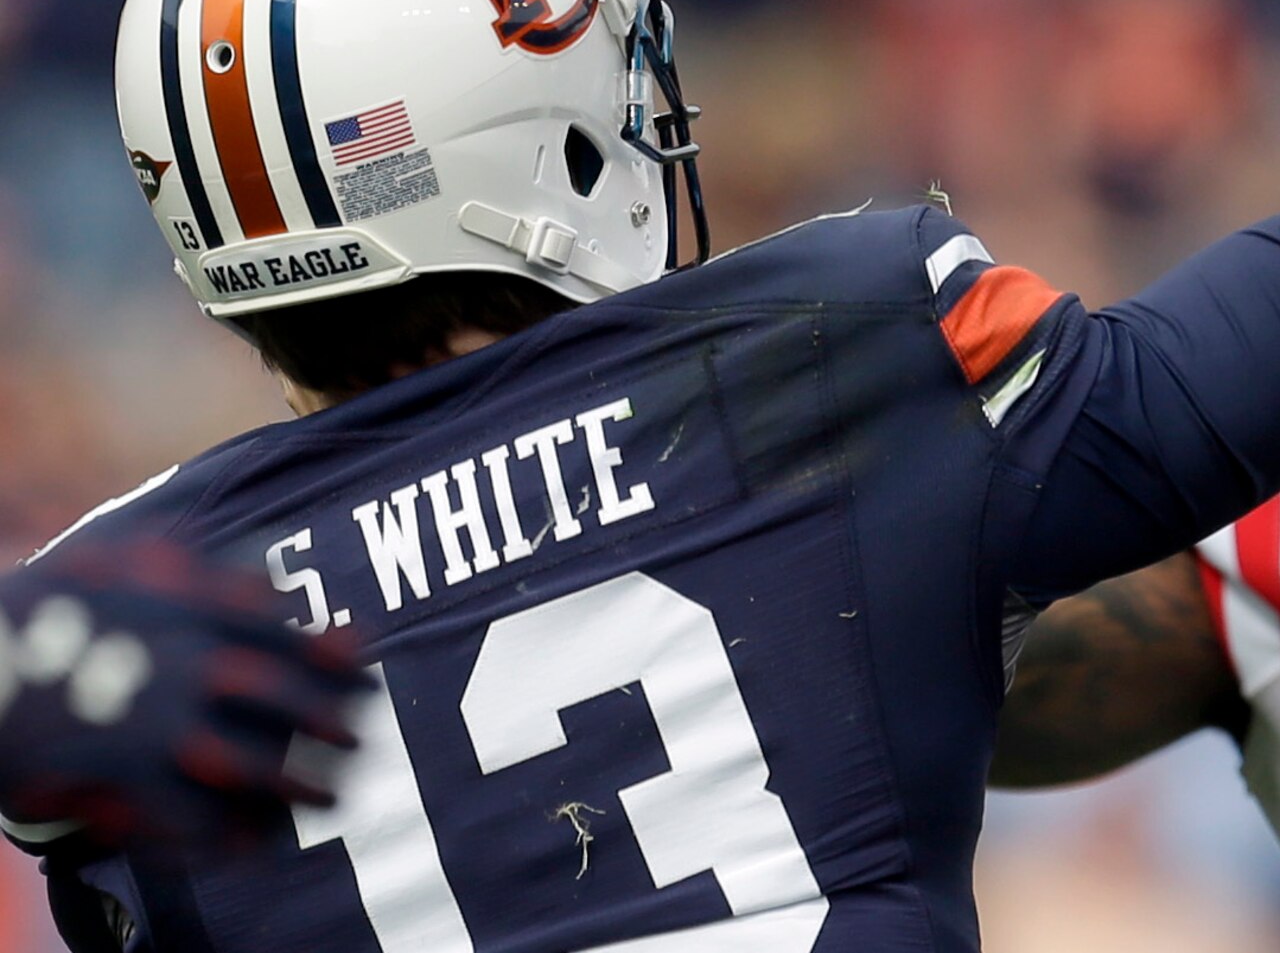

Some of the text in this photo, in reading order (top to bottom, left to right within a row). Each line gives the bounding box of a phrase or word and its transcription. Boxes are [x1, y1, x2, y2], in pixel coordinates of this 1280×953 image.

[173, 221, 200, 250] 13
[203, 242, 369, 294] WAR EAGLE
[265, 397, 655, 636] S. WHITE
[282, 571, 830, 953] 13
